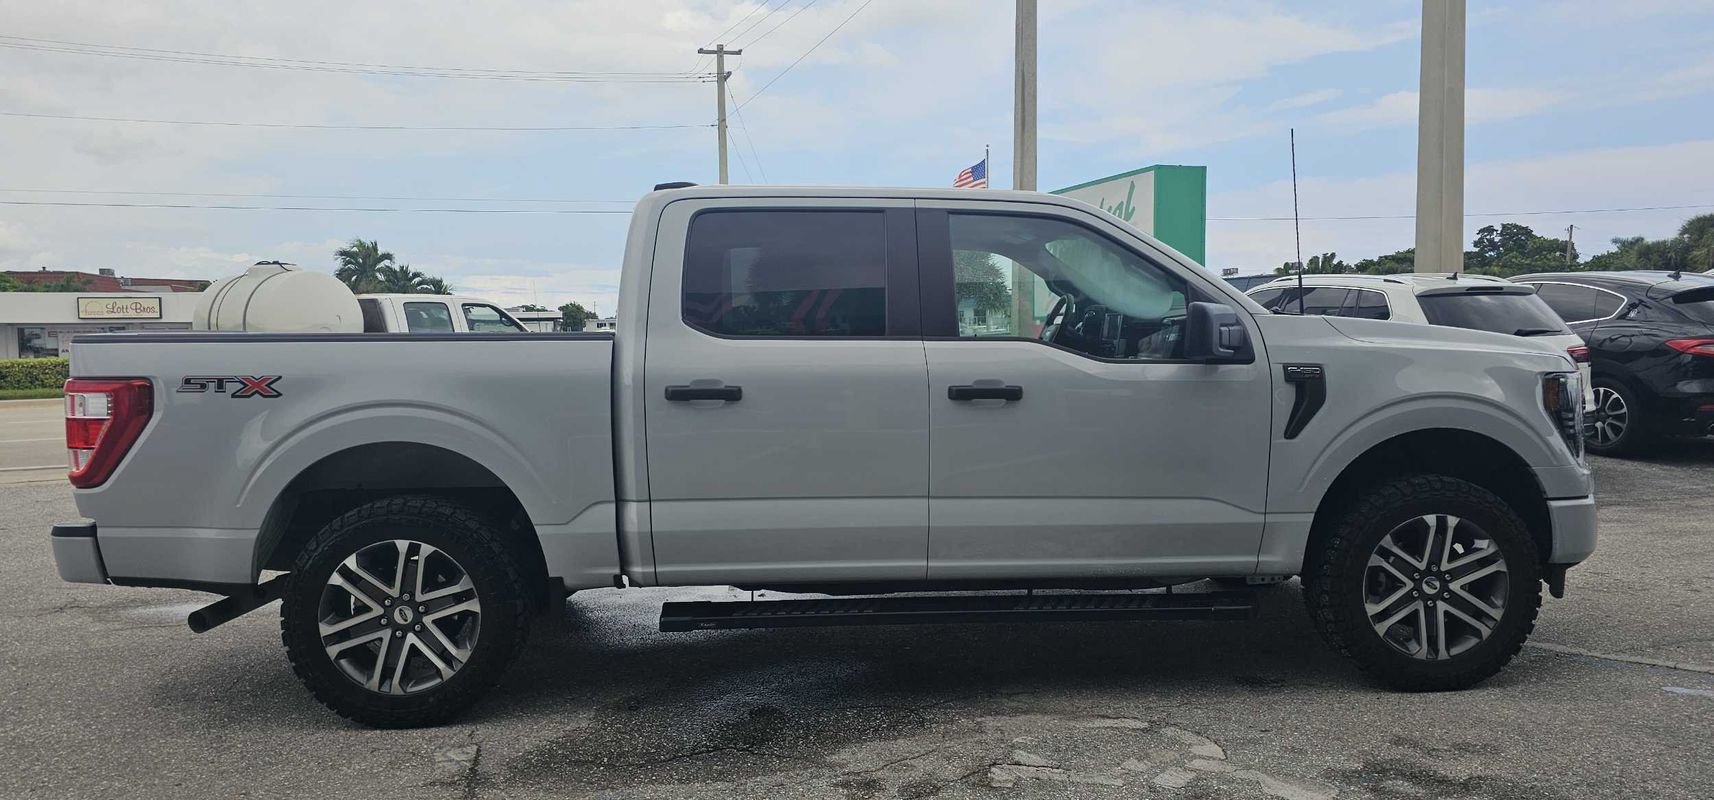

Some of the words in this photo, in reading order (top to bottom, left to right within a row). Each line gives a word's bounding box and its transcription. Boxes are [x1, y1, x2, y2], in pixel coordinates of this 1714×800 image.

[105, 301, 128, 314] Lott
[130, 301, 158, 314] Bros.
[176, 375, 283, 398] STX
